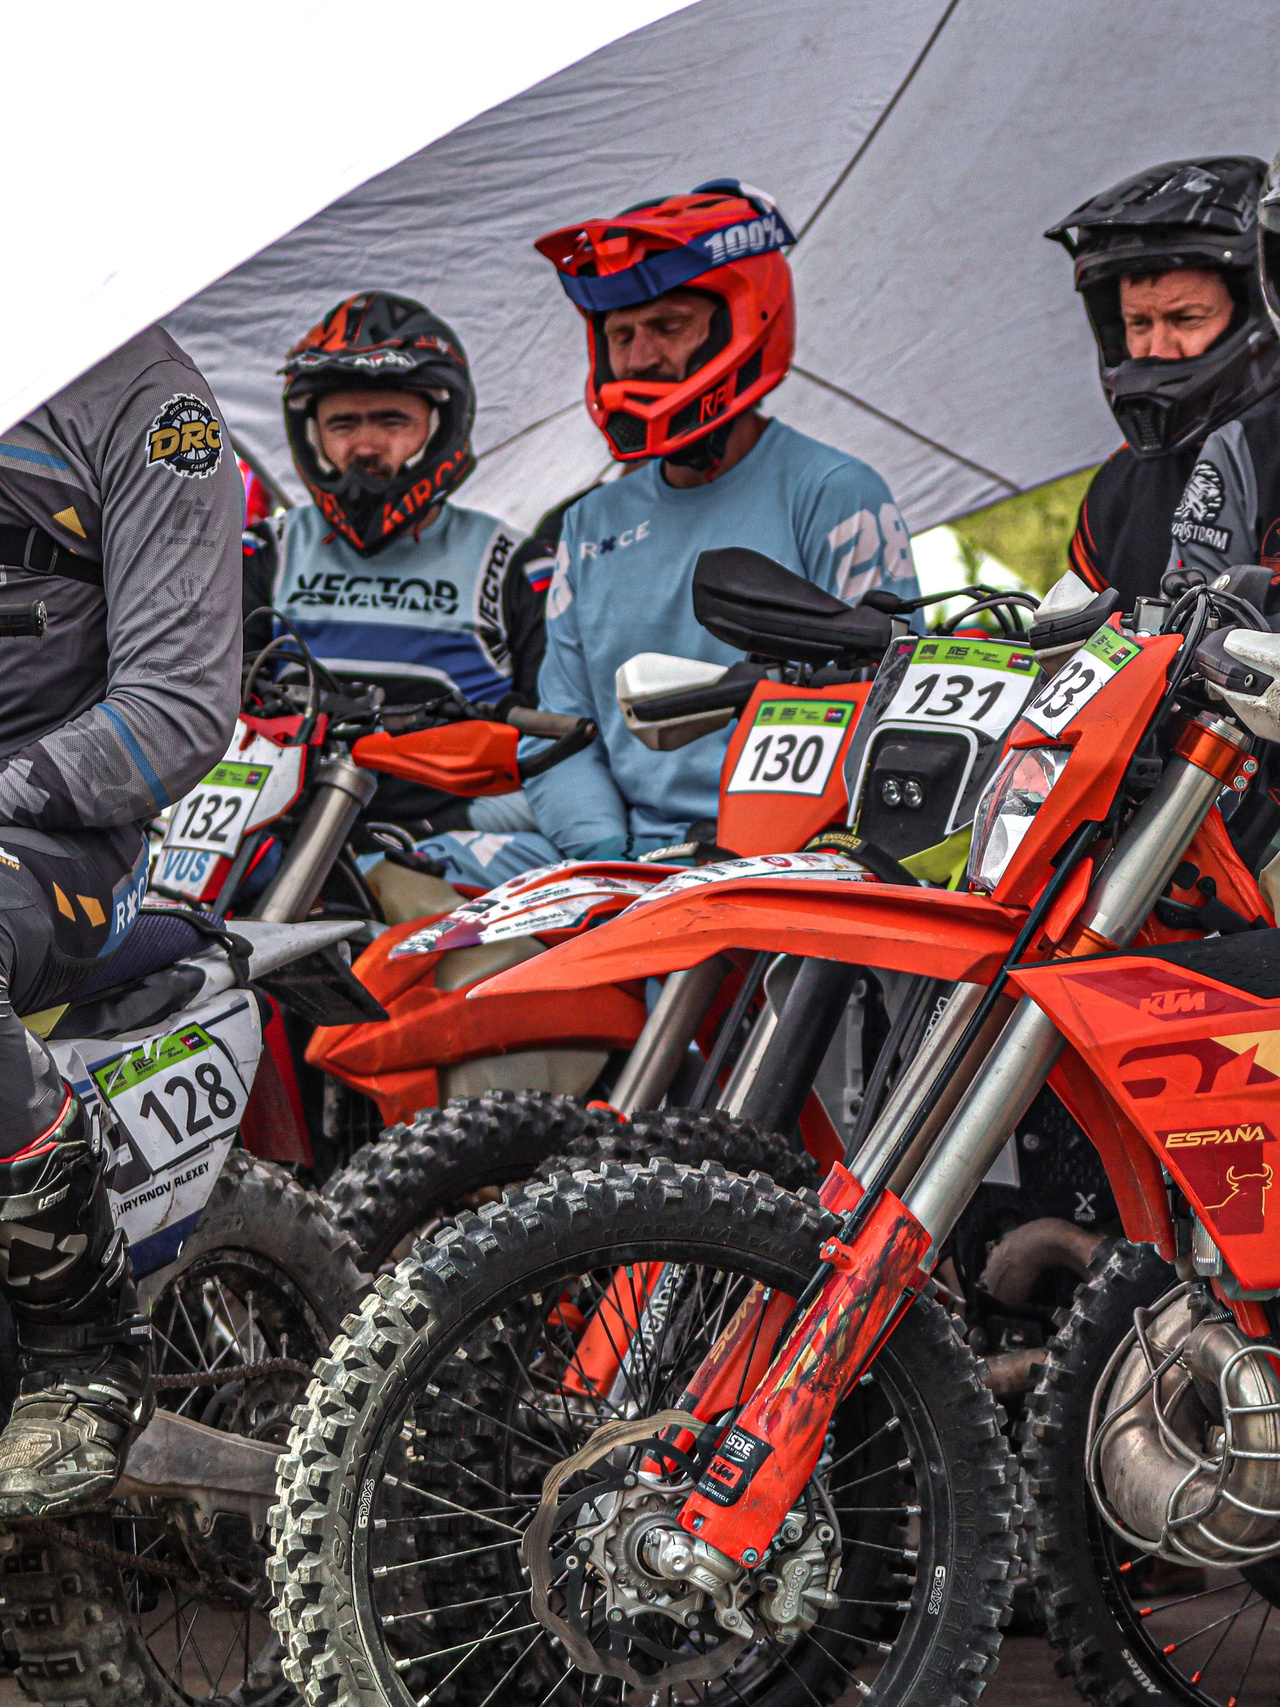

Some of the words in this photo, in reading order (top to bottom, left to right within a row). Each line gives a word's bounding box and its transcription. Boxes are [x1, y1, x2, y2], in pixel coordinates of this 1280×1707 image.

[705, 212, 785, 263] 100%
[169, 403, 183, 416] DIRT
[150, 420, 220, 461] DRC
[191, 461, 209, 470] CAMP
[288, 572, 460, 615] VECTOR
[479, 533, 515, 627] VECTOR
[905, 673, 1006, 722] 131
[1032, 659, 1096, 719] 33
[749, 733, 825, 784] 130
[179, 792, 243, 843] 132
[1139, 989, 1205, 1015] KTM
[140, 1062, 237, 1145] 128
[1164, 1123, 1266, 1148] ESPAÑA
[174, 1161, 209, 1188] ALEXEY
[1073, 1210, 1096, 1220] GRIP
[711, 1461, 736, 1481] KTM
[783, 1564, 807, 1618] brembo
[927, 1565, 947, 1616] 6DAYS
[1120, 1648, 1163, 1694] Mitas
